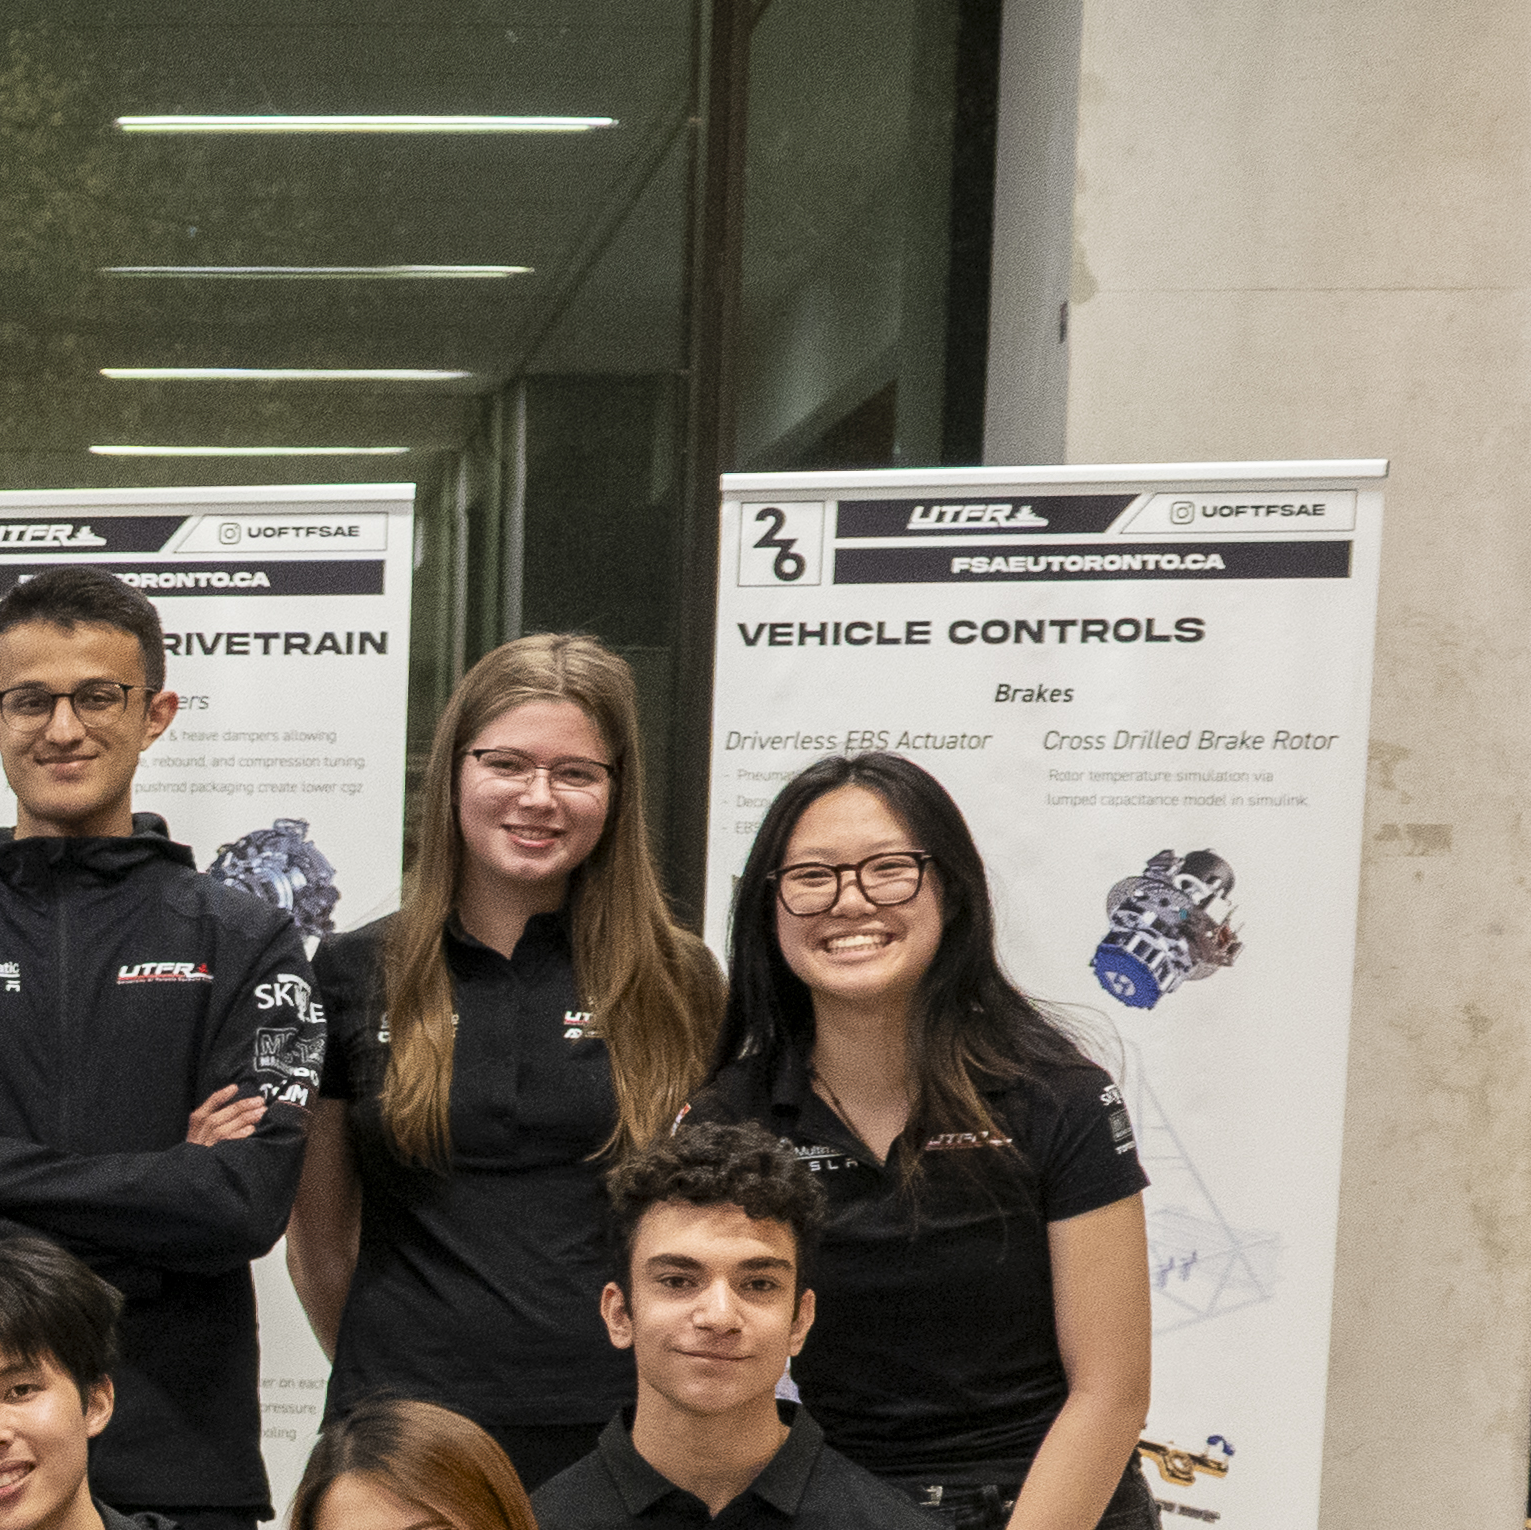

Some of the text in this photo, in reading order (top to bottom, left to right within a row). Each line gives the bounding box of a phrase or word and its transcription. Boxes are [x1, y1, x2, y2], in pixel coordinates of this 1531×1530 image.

[1201, 503, 1326, 518] UOFTFSAE
[247, 525, 361, 539] UOFTFSAE
[951, 553, 1226, 574] FSAEUTORONTO.CA
[737, 616, 1207, 648] VEHICLE CONTROLS
[163, 631, 389, 657] RIVETRAIN
[994, 683, 1075, 704] Brakes
[223, 730, 278, 743] dampers
[282, 730, 337, 744] allowing
[724, 729, 838, 751] Driverless
[895, 729, 994, 751] Actuator
[1042, 729, 1340, 752] Cross Drilled Brake Rotor
[211, 755, 236, 768] and
[238, 757, 321, 770] compression
[323, 756, 366, 771] tuning
[1048, 768, 1275, 784] Rotor temperature simulation via
[190, 781, 254, 796] packaging
[257, 781, 298, 793] create
[301, 781, 337, 793] lower
[1046, 793, 1098, 808] lumped
[1100, 793, 1179, 807] capacitance
[1183, 793, 1227, 807] model
[1230, 794, 1245, 806] in
